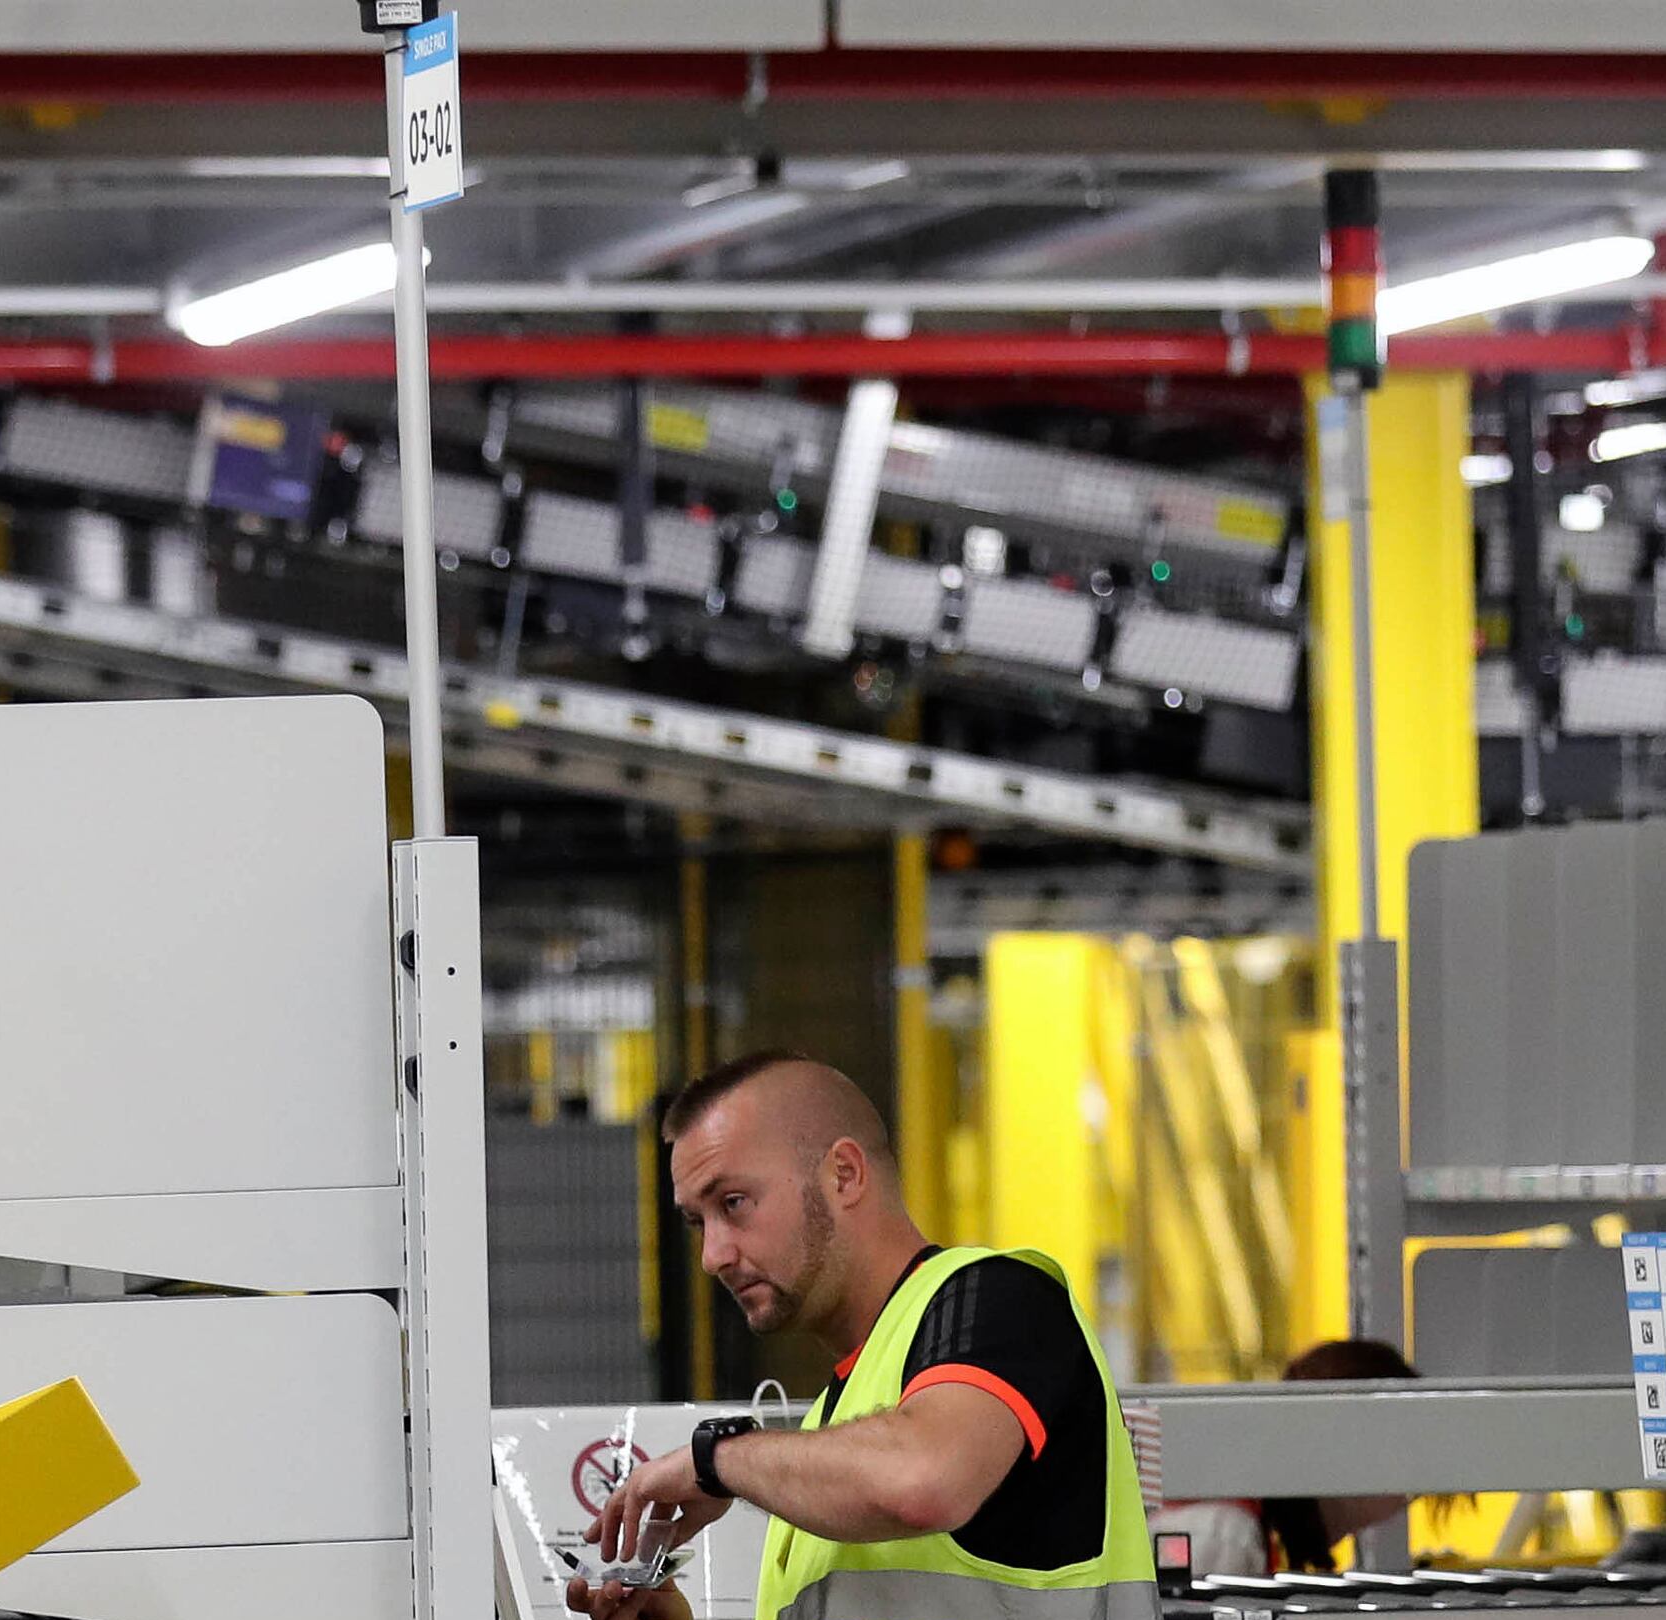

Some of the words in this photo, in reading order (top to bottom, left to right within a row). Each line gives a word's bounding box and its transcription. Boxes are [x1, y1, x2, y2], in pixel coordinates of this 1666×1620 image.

[414, 36, 433, 60] SINGLE
[434, 31, 447, 51] PACK
[409, 100, 452, 165] 03-02
